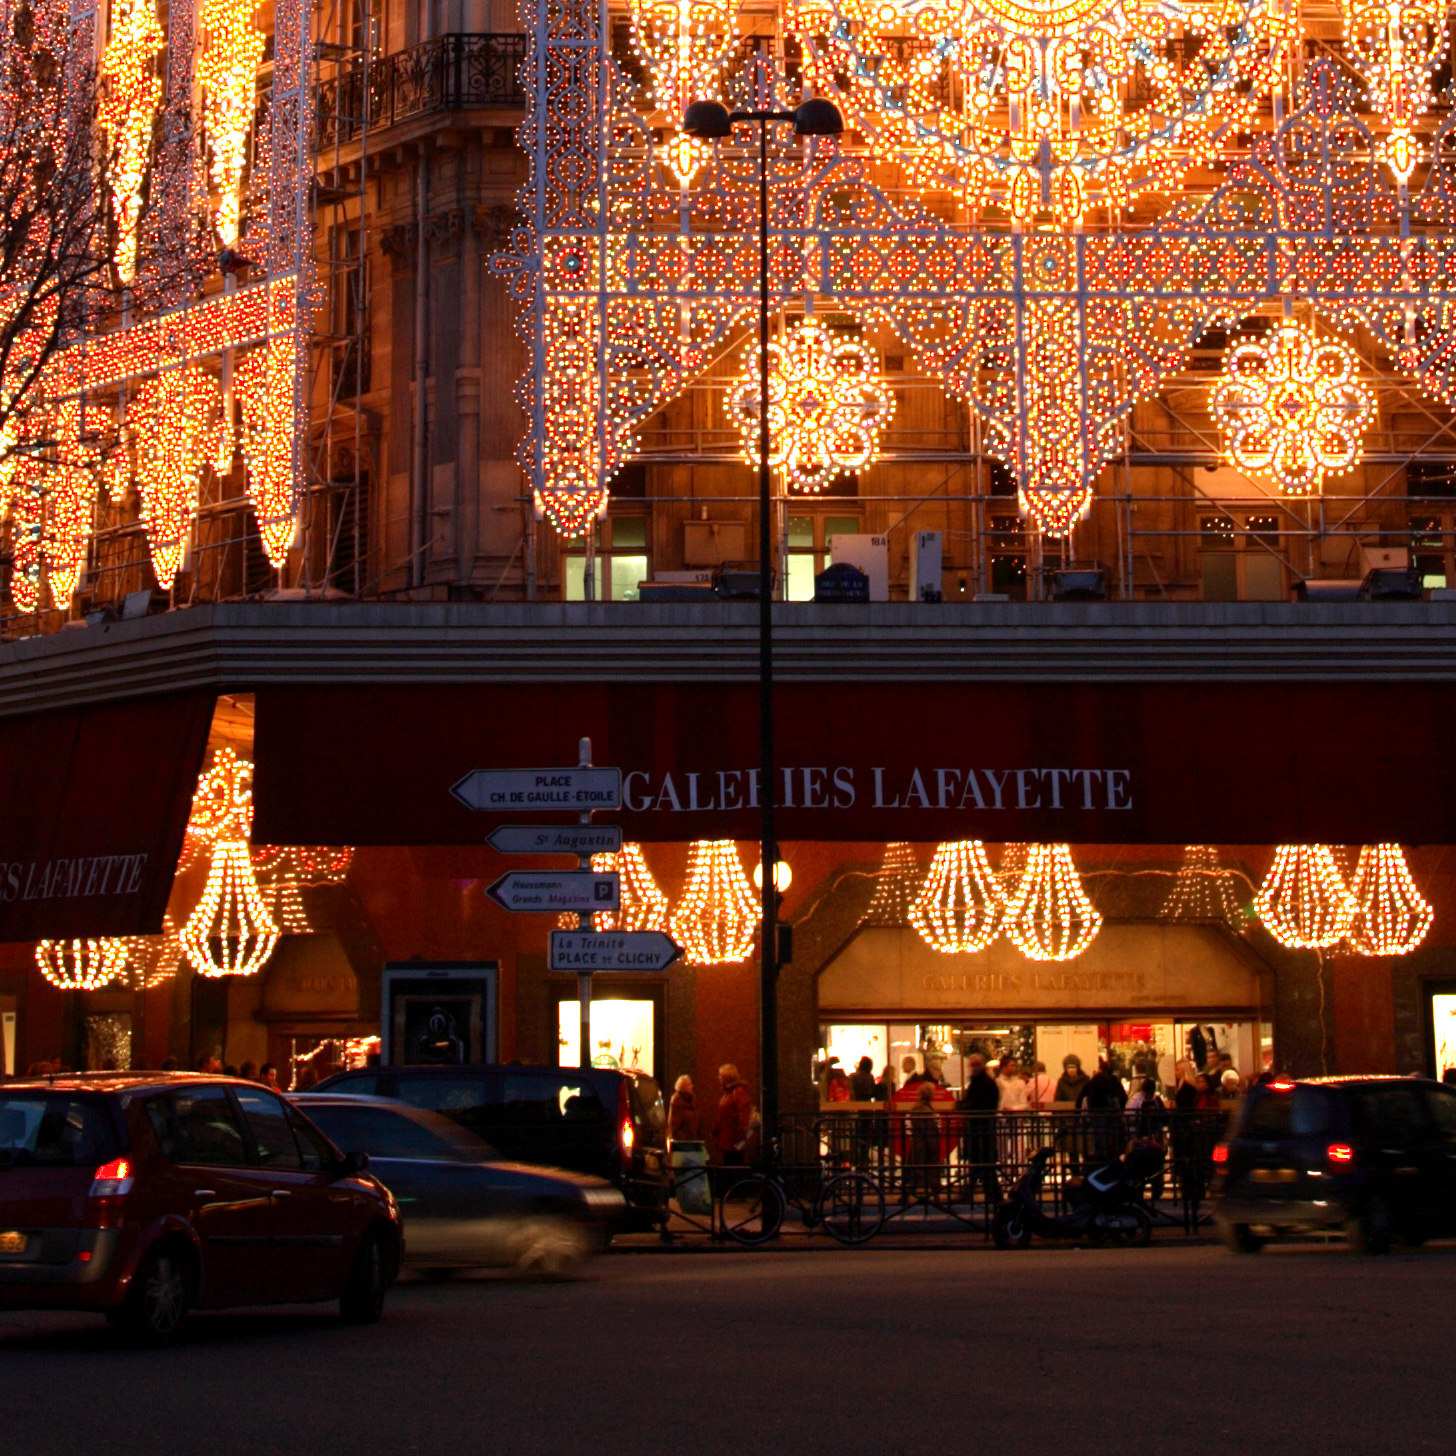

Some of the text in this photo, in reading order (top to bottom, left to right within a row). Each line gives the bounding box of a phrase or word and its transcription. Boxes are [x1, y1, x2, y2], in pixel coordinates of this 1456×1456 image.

[535, 776, 572, 787] PLACE
[870, 766, 1133, 811] LAFAYETTE
[509, 792, 525, 802] DE
[556, 834, 614, 848] Augustin
[21, 853, 149, 901] LAFAYETTE
[512, 880, 562, 890] Haussmann
[512, 894, 590, 905] Grands Magasins
[558, 937, 625, 949] La Trinité
[558, 953, 597, 964] PLACE
[617, 953, 661, 964] CLICHY
[922, 973, 1021, 991] GALERIES
